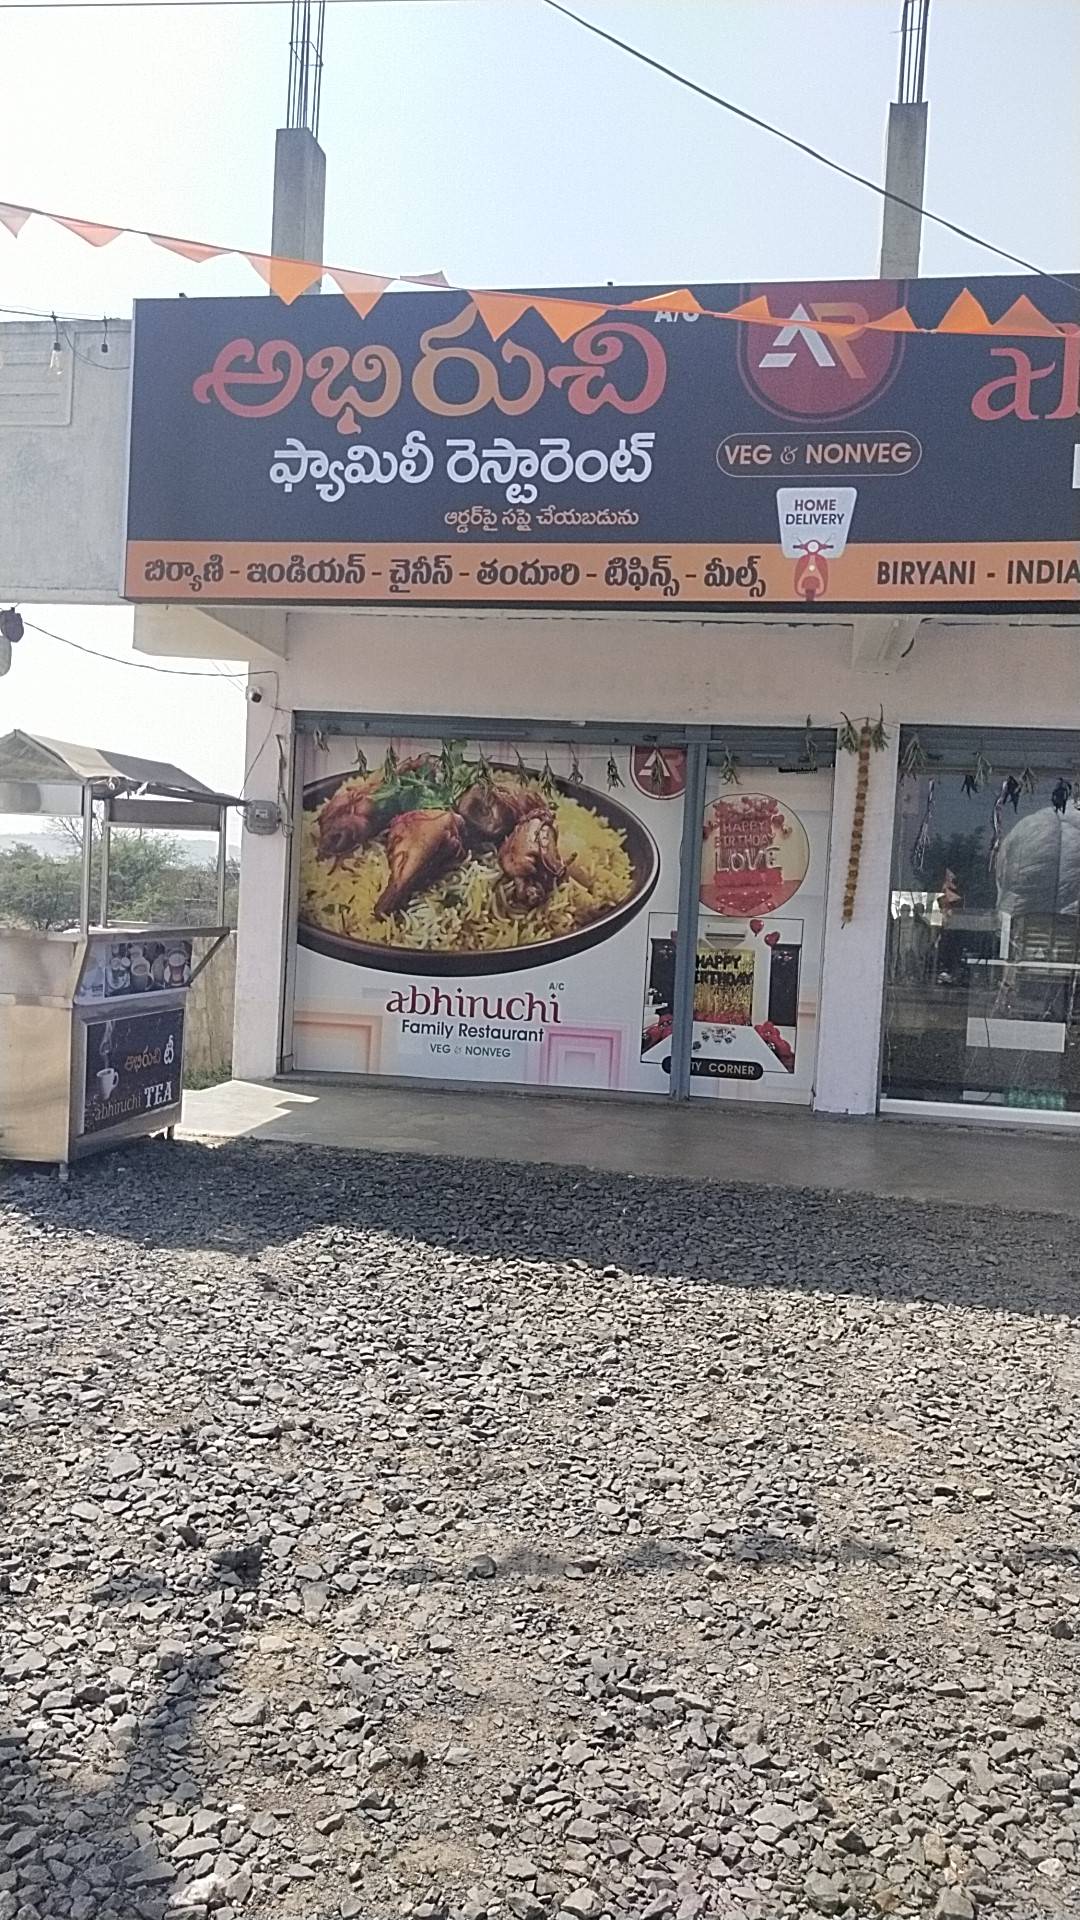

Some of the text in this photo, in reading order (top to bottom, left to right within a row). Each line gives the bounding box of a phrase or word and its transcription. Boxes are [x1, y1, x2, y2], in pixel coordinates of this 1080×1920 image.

[193, 302, 667, 435] అభిరుచి
[725, 443, 912, 465] VEG & NONVEG
[270, 430, 655, 504] ఫ్యామిలీ రెస్టారెంట్
[536, 505, 639, 526] చేయబడును
[794, 500, 836, 511] HOME
[785, 513, 845, 525] DELIVERY
[144, 554, 224, 591] బిర్యాణి
[247, 553, 366, 585] ఇండియన్
[389, 555, 453, 593] చైనీస్
[476, 558, 580, 586] తందూరి
[604, 555, 680, 597] టిఫిన్స్
[704, 555, 766, 597] మీల్స్
[877, 561, 975, 584] BIRYANI
[1007, 560, 1080, 584] INDIA
[723, 820, 765, 833] HAPPY
[716, 847, 782, 873] LOVE
[696, 954, 741, 969] HAPPY
[549, 982, 565, 991] A/C
[386, 985, 561, 1024] abhiruchi
[401, 1020, 544, 1042] Family Restaurant
[430, 1043, 451, 1053] VEG
[465, 1045, 511, 1058] NONVEG
[709, 1063, 755, 1075] CORNER
[144, 1081, 172, 1108] TEA
